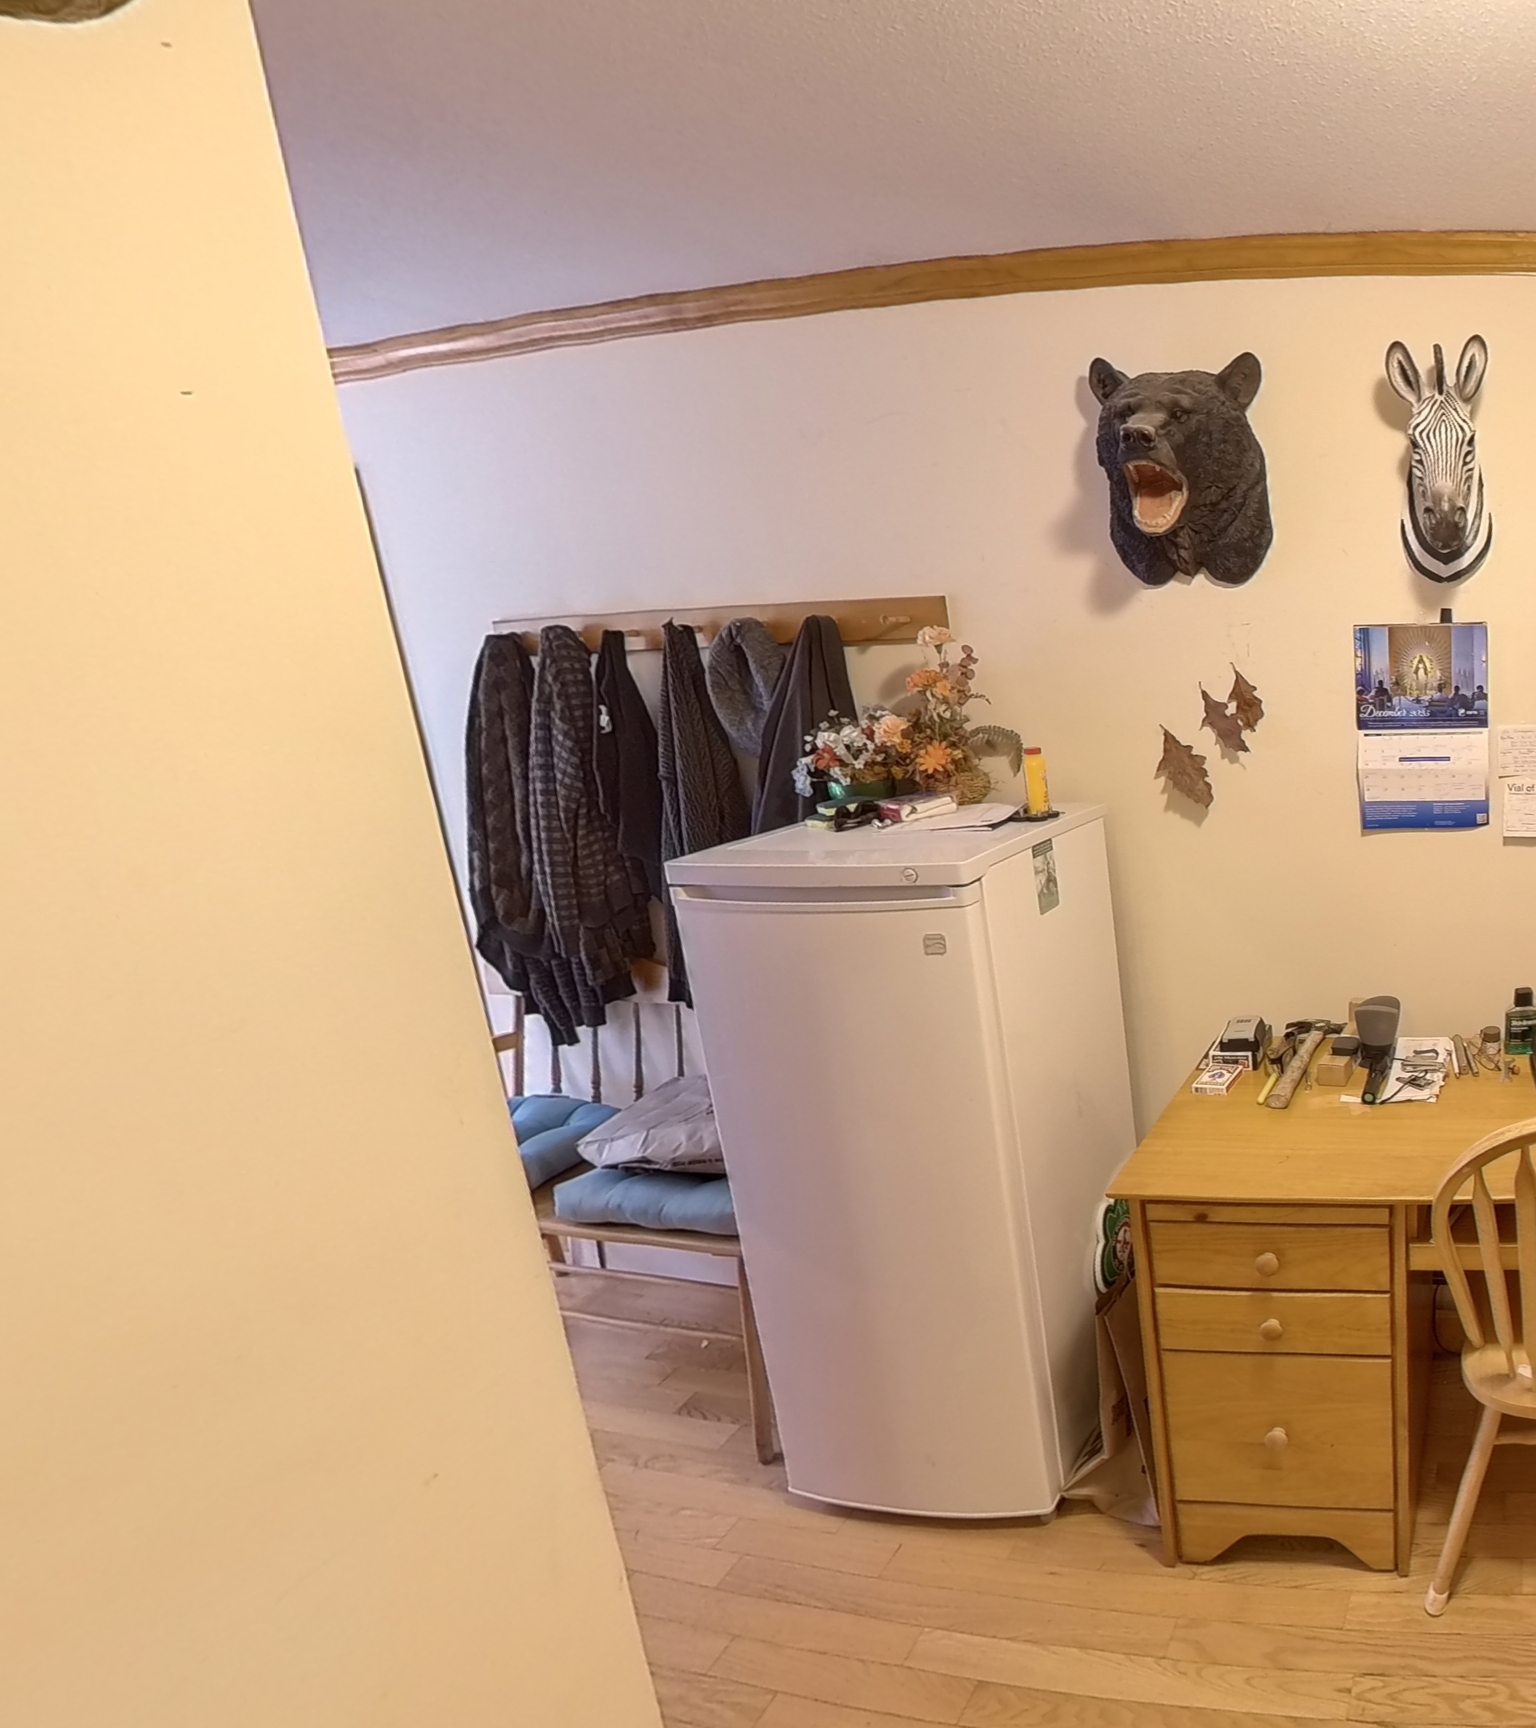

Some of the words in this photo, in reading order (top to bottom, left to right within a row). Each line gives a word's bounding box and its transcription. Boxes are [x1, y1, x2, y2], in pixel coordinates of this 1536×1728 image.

[1359, 704, 1406, 717] December
[1507, 783, 1524, 792] Vial
[1526, 783, 1535, 792] of
